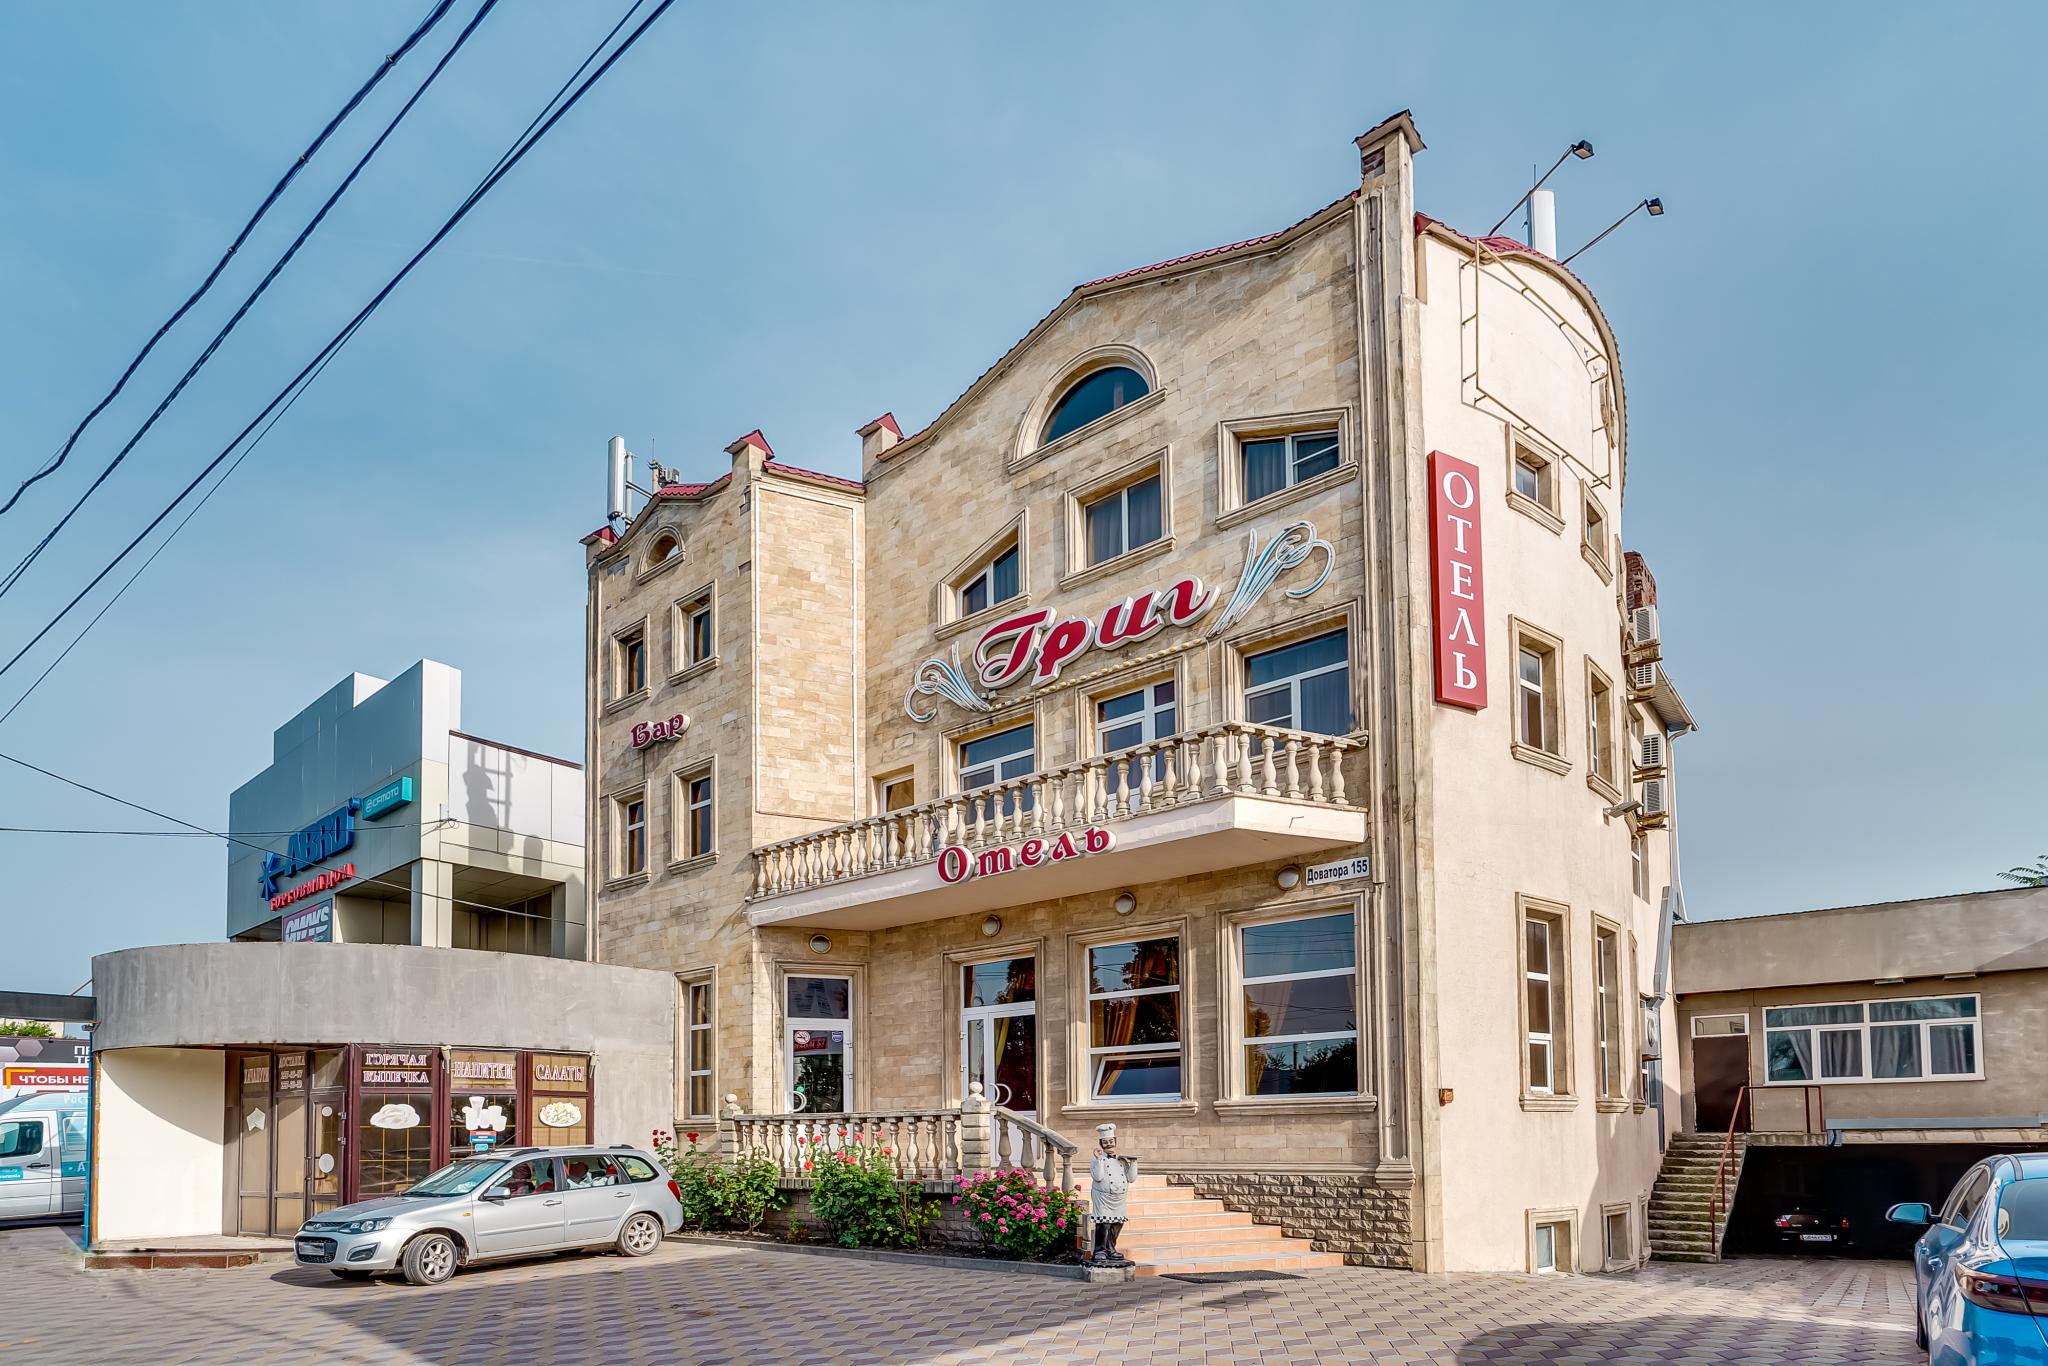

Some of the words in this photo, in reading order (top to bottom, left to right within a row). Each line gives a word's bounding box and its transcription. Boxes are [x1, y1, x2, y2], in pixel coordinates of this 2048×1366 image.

[1442, 471, 1480, 690] ОТЕЛЬ
[972, 575, 1219, 688] Григ
[631, 713, 689, 749] Бар
[284, 805, 353, 877] ABRO
[937, 826, 1116, 884] Отель
[1307, 865, 1348, 883] Доватора
[1351, 859, 1368, 874] 155
[365, 1053, 427, 1066] ГОРЯЧАЯ
[454, 1062, 513, 1080] НАПИТКИ
[19, 1075, 69, 1084] ЧТОБЫ
[363, 1070, 429, 1083] ВЫПЕЧКА
[535, 1064, 585, 1081] САЛАТЫ
